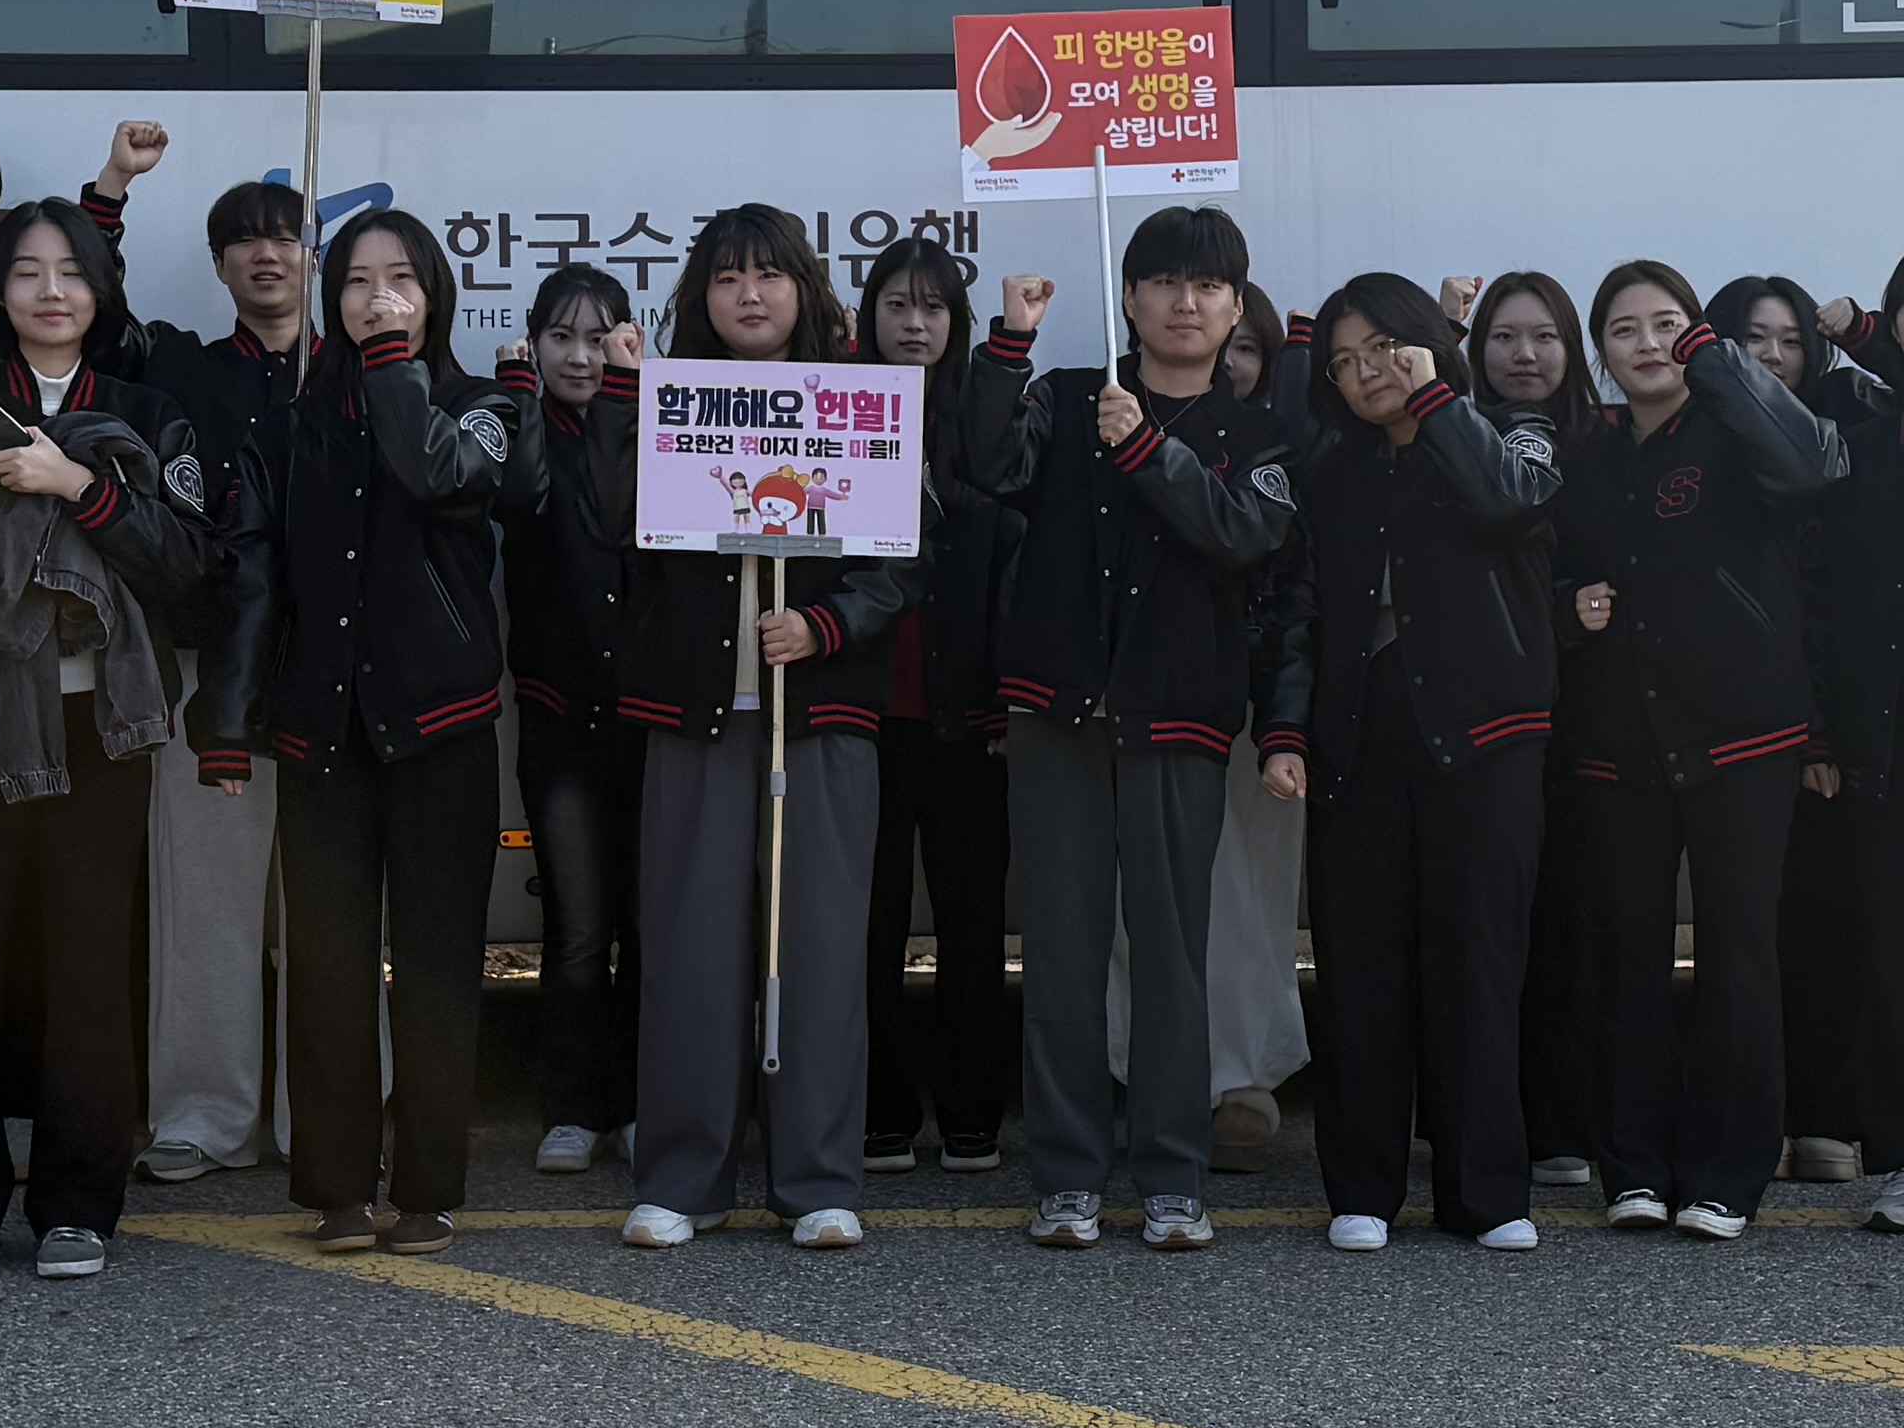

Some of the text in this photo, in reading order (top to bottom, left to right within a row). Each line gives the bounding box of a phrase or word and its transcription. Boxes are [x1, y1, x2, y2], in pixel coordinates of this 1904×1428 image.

[1052, 27, 1215, 69] 피 한방울이
[1067, 72, 1218, 112] 모여 생명을
[1104, 113, 1218, 150] 살립니다!
[462, 308, 512, 329] THE
[656, 383, 902, 434] 함께해요 헌혈!
[655, 432, 734, 455] 중요한건
[805, 437, 844, 458] 않는
[848, 437, 901, 461] 마음!!
